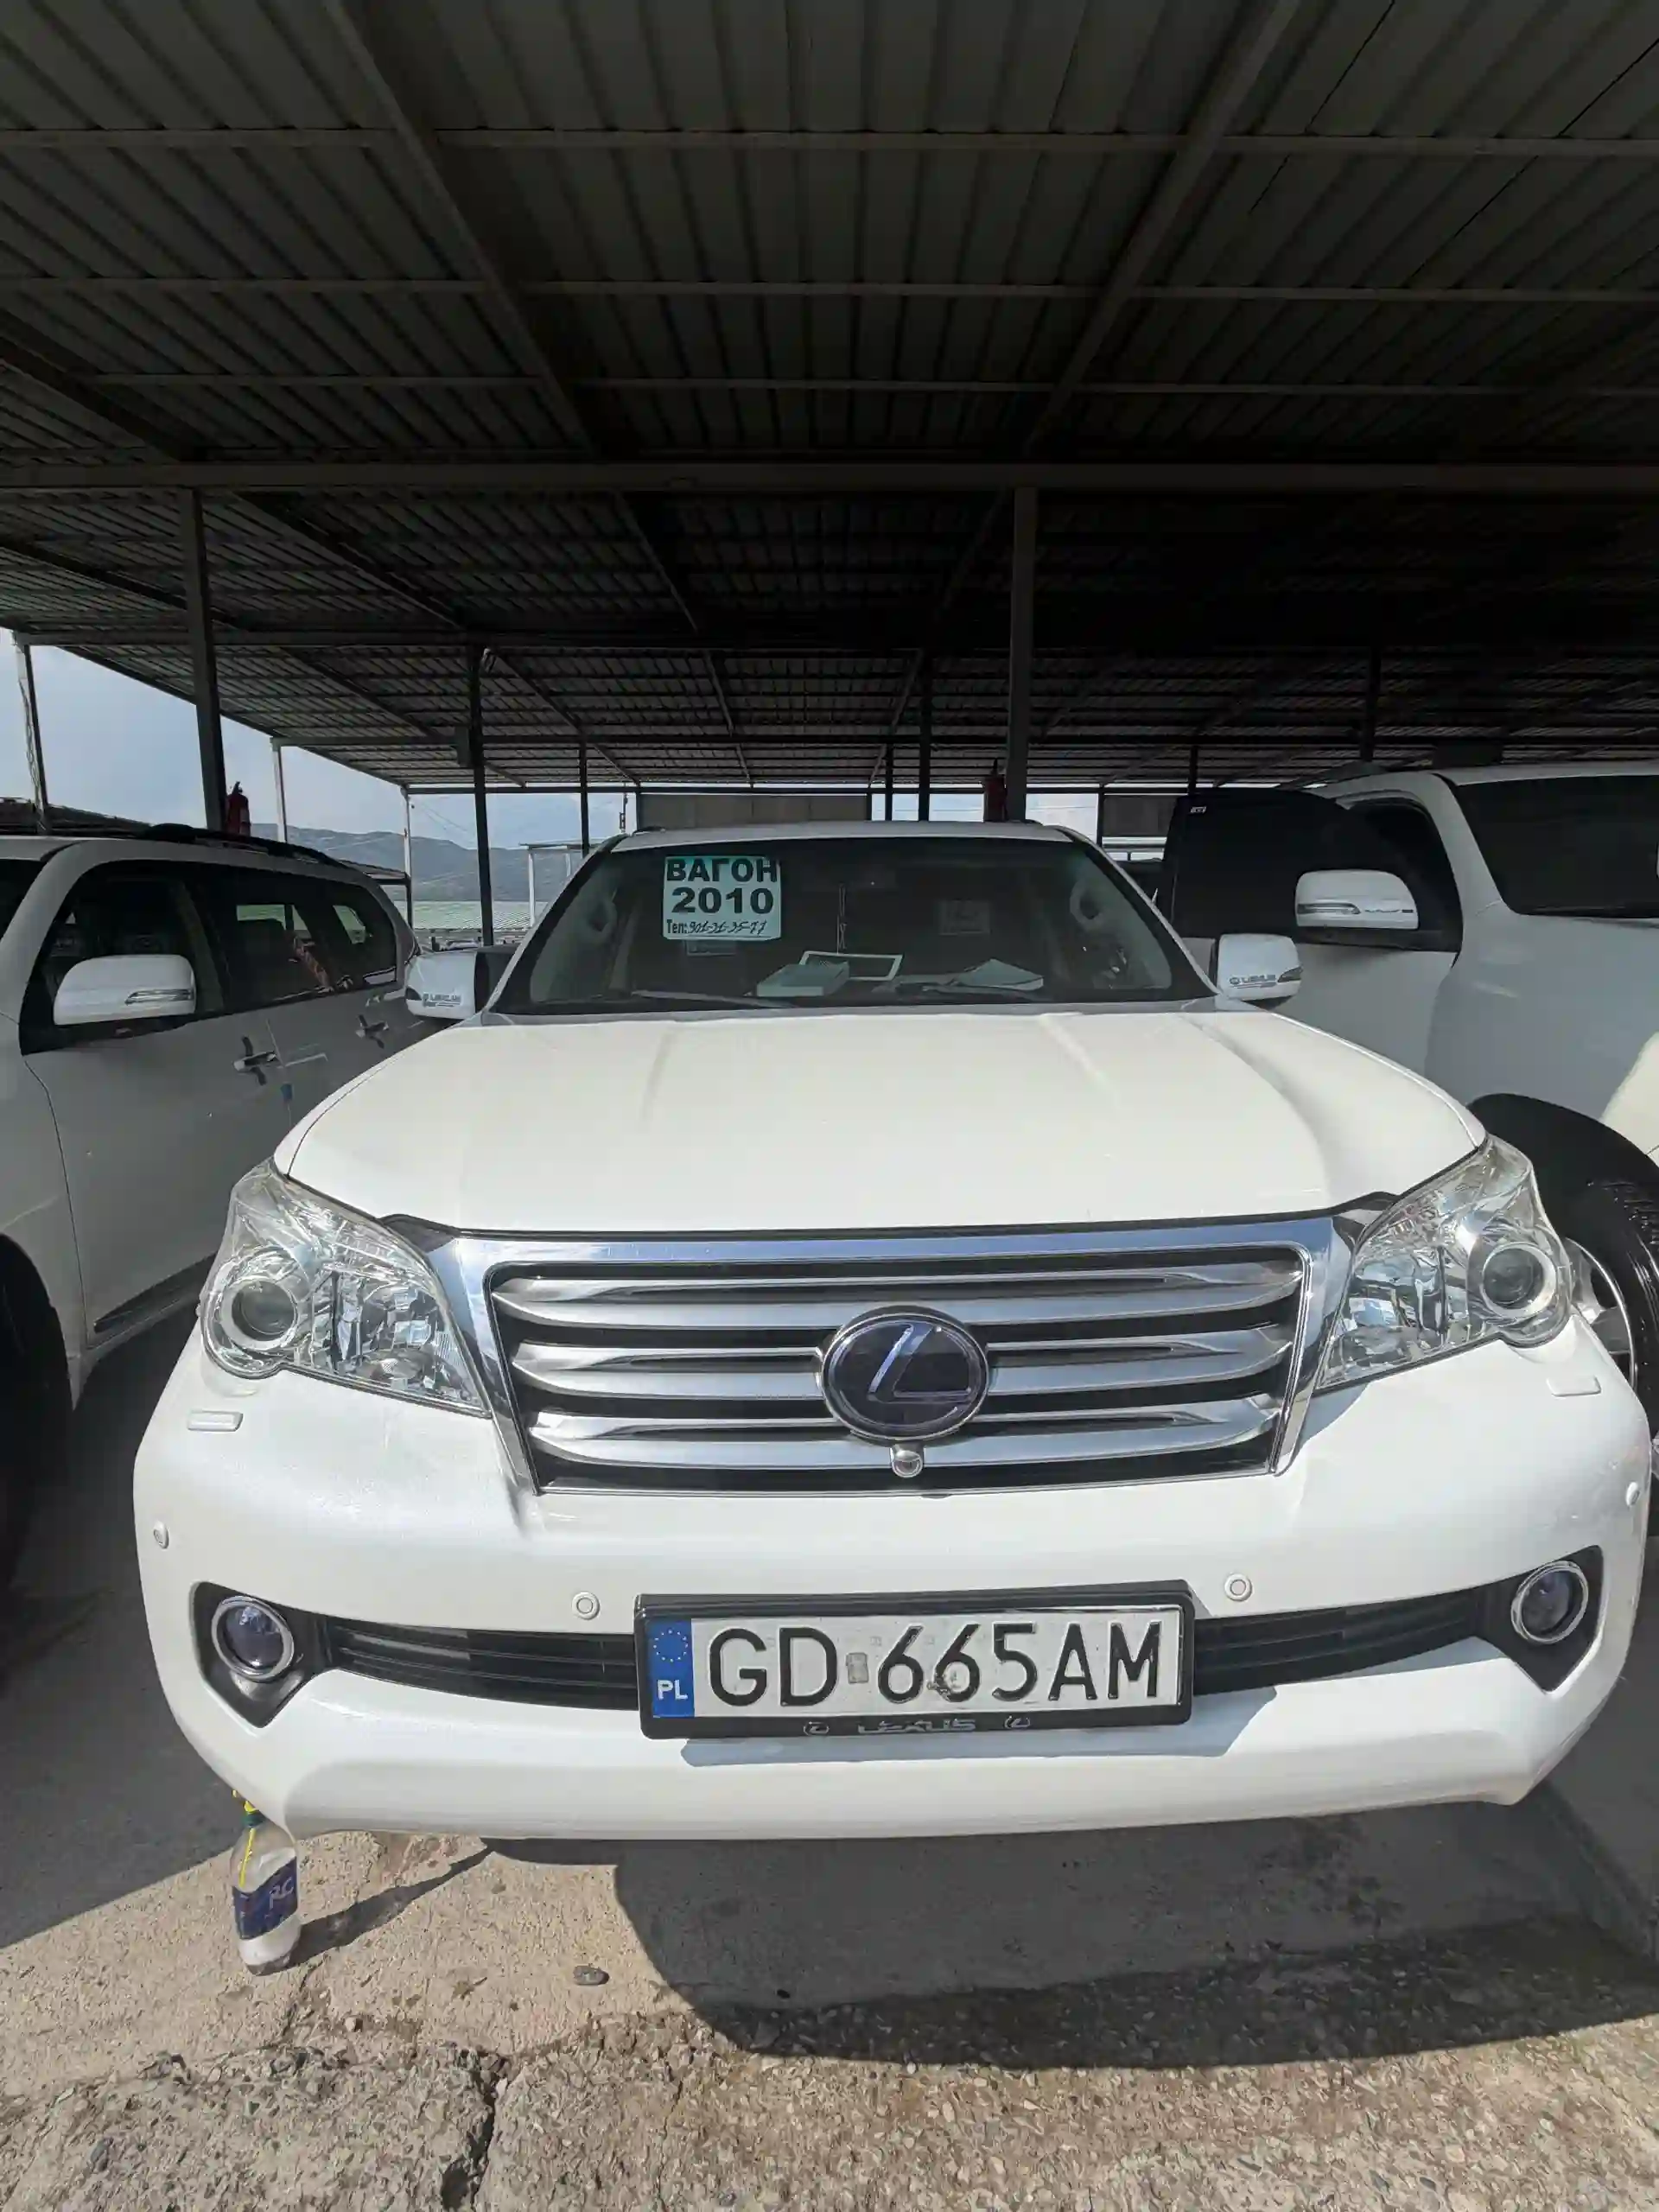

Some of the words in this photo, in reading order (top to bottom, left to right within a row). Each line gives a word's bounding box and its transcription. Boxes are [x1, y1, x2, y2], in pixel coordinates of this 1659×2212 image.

[666, 858, 778, 882] ВАГОН
[671, 887, 774, 914] 2010
[709, 1627, 837, 1707] GD
[878, 1621, 1161, 1704] 665AM
[657, 1679, 689, 1700] PL
